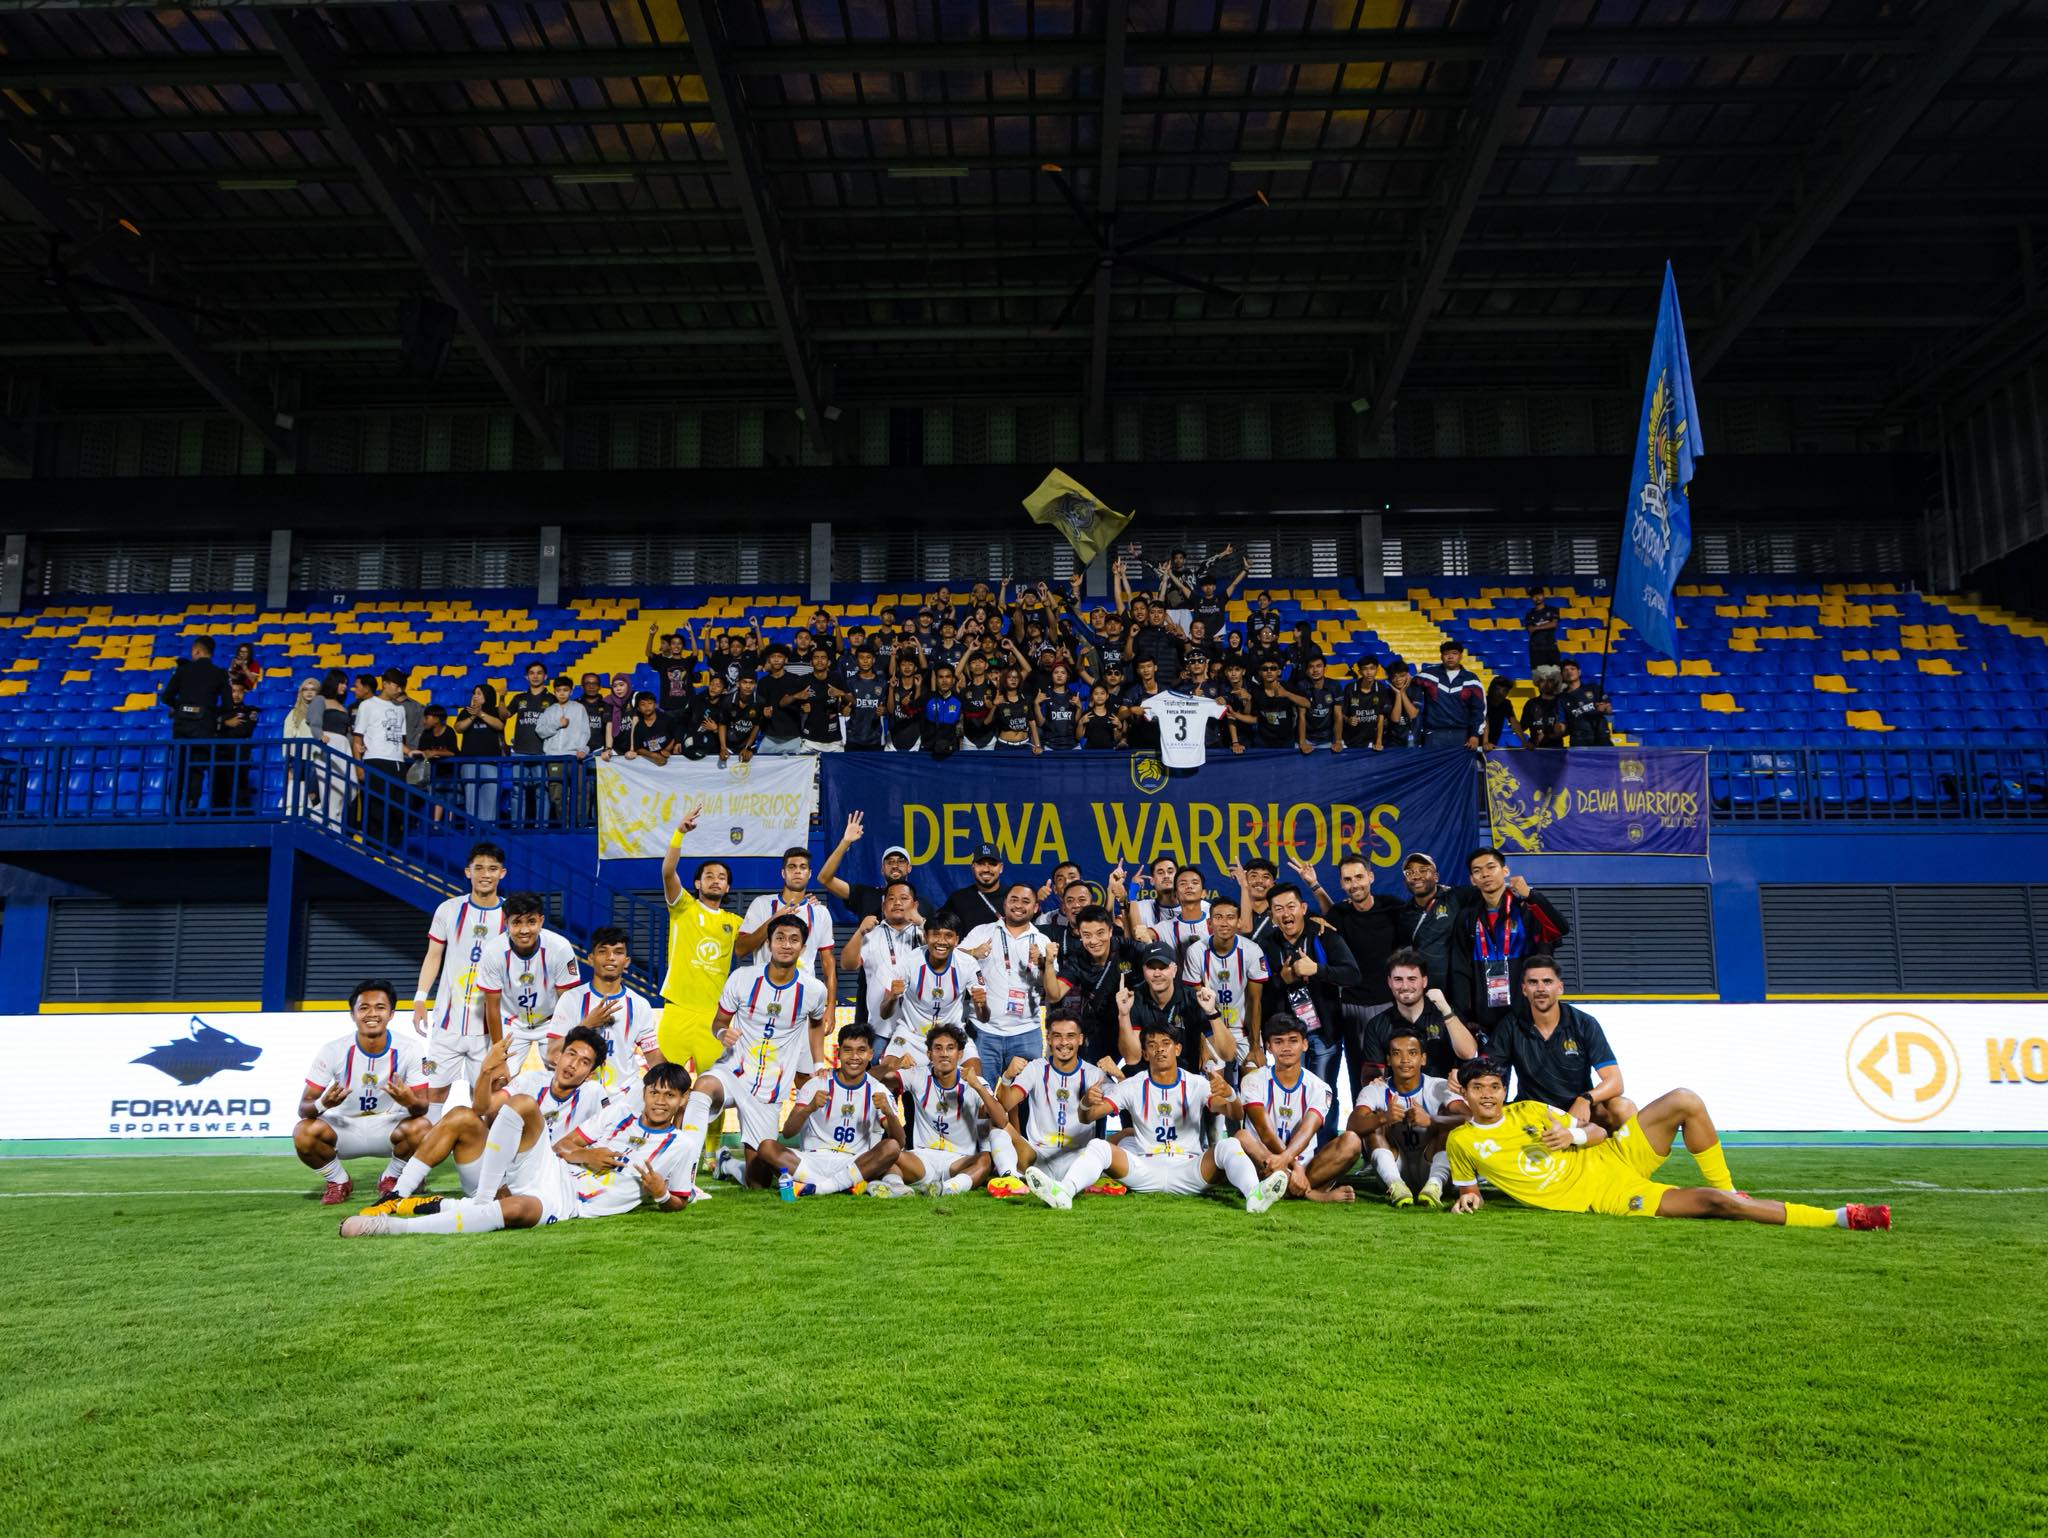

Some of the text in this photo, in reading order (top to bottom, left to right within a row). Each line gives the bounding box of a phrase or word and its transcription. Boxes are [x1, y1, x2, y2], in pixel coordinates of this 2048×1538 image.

[333, 595, 345, 604] F7
[856, 698, 878, 708] DEWA
[1174, 715, 1187, 741] 3
[728, 792, 801, 817] WARRIORS
[1577, 789, 1698, 816] DEWA WARRIORS
[903, 802, 1401, 879] DEWA WARRIORS
[698, 914, 705, 927] 1
[470, 946, 482, 963] 6
[518, 992, 538, 1009] 27
[1217, 990, 1233, 1003] 18
[763, 1024, 775, 1039] 5
[640, 1040, 656, 1050] Cap
[1986, 1037, 2048, 1084] KO
[111, 1099, 271, 1117] FORWARD
[359, 1096, 378, 1110] 13
[1057, 1111, 1067, 1125] 8
[109, 1122, 270, 1132] SPORTSWEAR
[834, 1126, 856, 1143] 66
[1155, 1126, 1178, 1142] 24
[1402, 1131, 1420, 1146] 10
